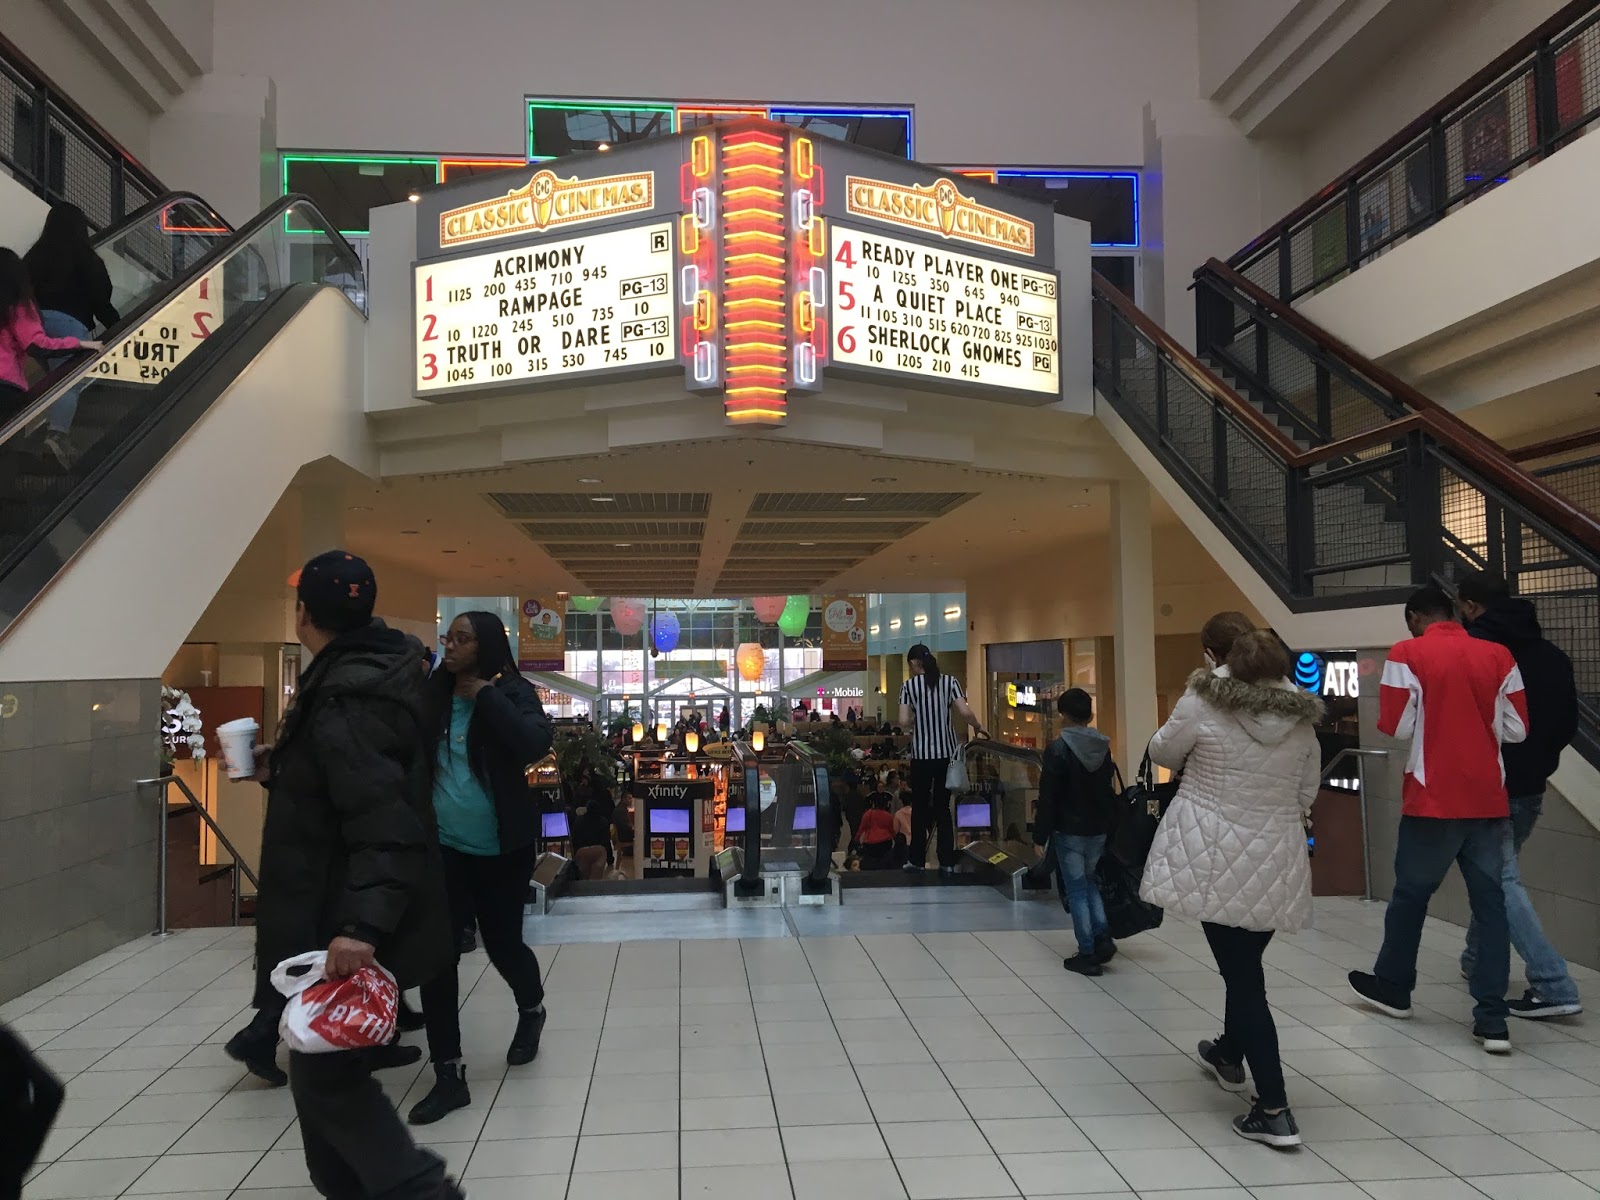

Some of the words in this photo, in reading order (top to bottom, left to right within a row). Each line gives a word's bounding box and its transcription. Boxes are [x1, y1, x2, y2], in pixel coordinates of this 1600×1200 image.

[447, 201, 529, 237] CLASSIC
[555, 183, 643, 216] CINEMAS
[854, 186, 935, 223] CLASSIC
[957, 209, 1027, 244] CINEMAS
[655, 235, 665, 248] R
[835, 241, 857, 269] 4
[494, 245, 584, 278] ACRIMONY
[862, 241, 915, 268] READY
[925, 254, 984, 283] PLAYER
[991, 269, 1018, 290] ONE
[425, 275, 433, 301] 1
[449, 288, 472, 302] 1125
[484, 282, 506, 297] 200
[515, 278, 536, 291] 435
[551, 272, 572, 286] 710
[583, 266, 607, 281] 945
[622, 278, 665, 295] PG-13
[838, 281, 856, 310] 5
[867, 266, 879, 279] 10
[893, 272, 917, 286] 1255
[930, 279, 949, 292] 350
[964, 286, 985, 300] 645
[1000, 292, 1020, 307] 940
[1023, 278, 1055, 296] PG-13
[499, 288, 582, 317] RAMPAGE
[873, 285, 883, 303] A
[897, 290, 945, 314] QUIET
[956, 300, 1002, 325] PLACE
[422, 314, 438, 341] 2
[448, 330, 460, 342] 10
[472, 324, 498, 338] 1220
[512, 319, 533, 333] 245
[552, 314, 574, 327] 510
[592, 307, 614, 321] 735
[635, 302, 649, 315] 10
[623, 320, 666, 338] PG-13
[861, 306, 870, 318] 11
[877, 309, 897, 323] 105
[903, 314, 922, 328] 310
[929, 318, 946, 332] 515
[950, 322, 970, 336] 620
[973, 326, 990, 339] 720
[994, 330, 1011, 343] 825
[1016, 334, 1033, 347] 925
[1034, 338, 1057, 351] 1030
[1019, 316, 1050, 332] PG-13
[447, 340, 501, 364] TRUTH
[518, 336, 540, 355] OR
[562, 326, 610, 349] DARE
[837, 326, 856, 353] 6
[868, 325, 950, 355] SHERLOCK
[963, 341, 1021, 367] GNOMES
[422, 353, 438, 380] 3
[447, 367, 474, 382] 1045
[491, 363, 512, 376] 100
[528, 358, 548, 372] 315
[562, 353, 584, 367] 530
[604, 348, 627, 362] 745
[650, 343, 664, 356] 10
[870, 349, 883, 362] 10
[898, 354, 922, 368] 1205
[932, 359, 950, 373] 210
[961, 364, 980, 377] 415
[1035, 356, 1049, 369] PG
[648, 784, 688, 799] xfinity
[328, 1004, 361, 1024] BY
